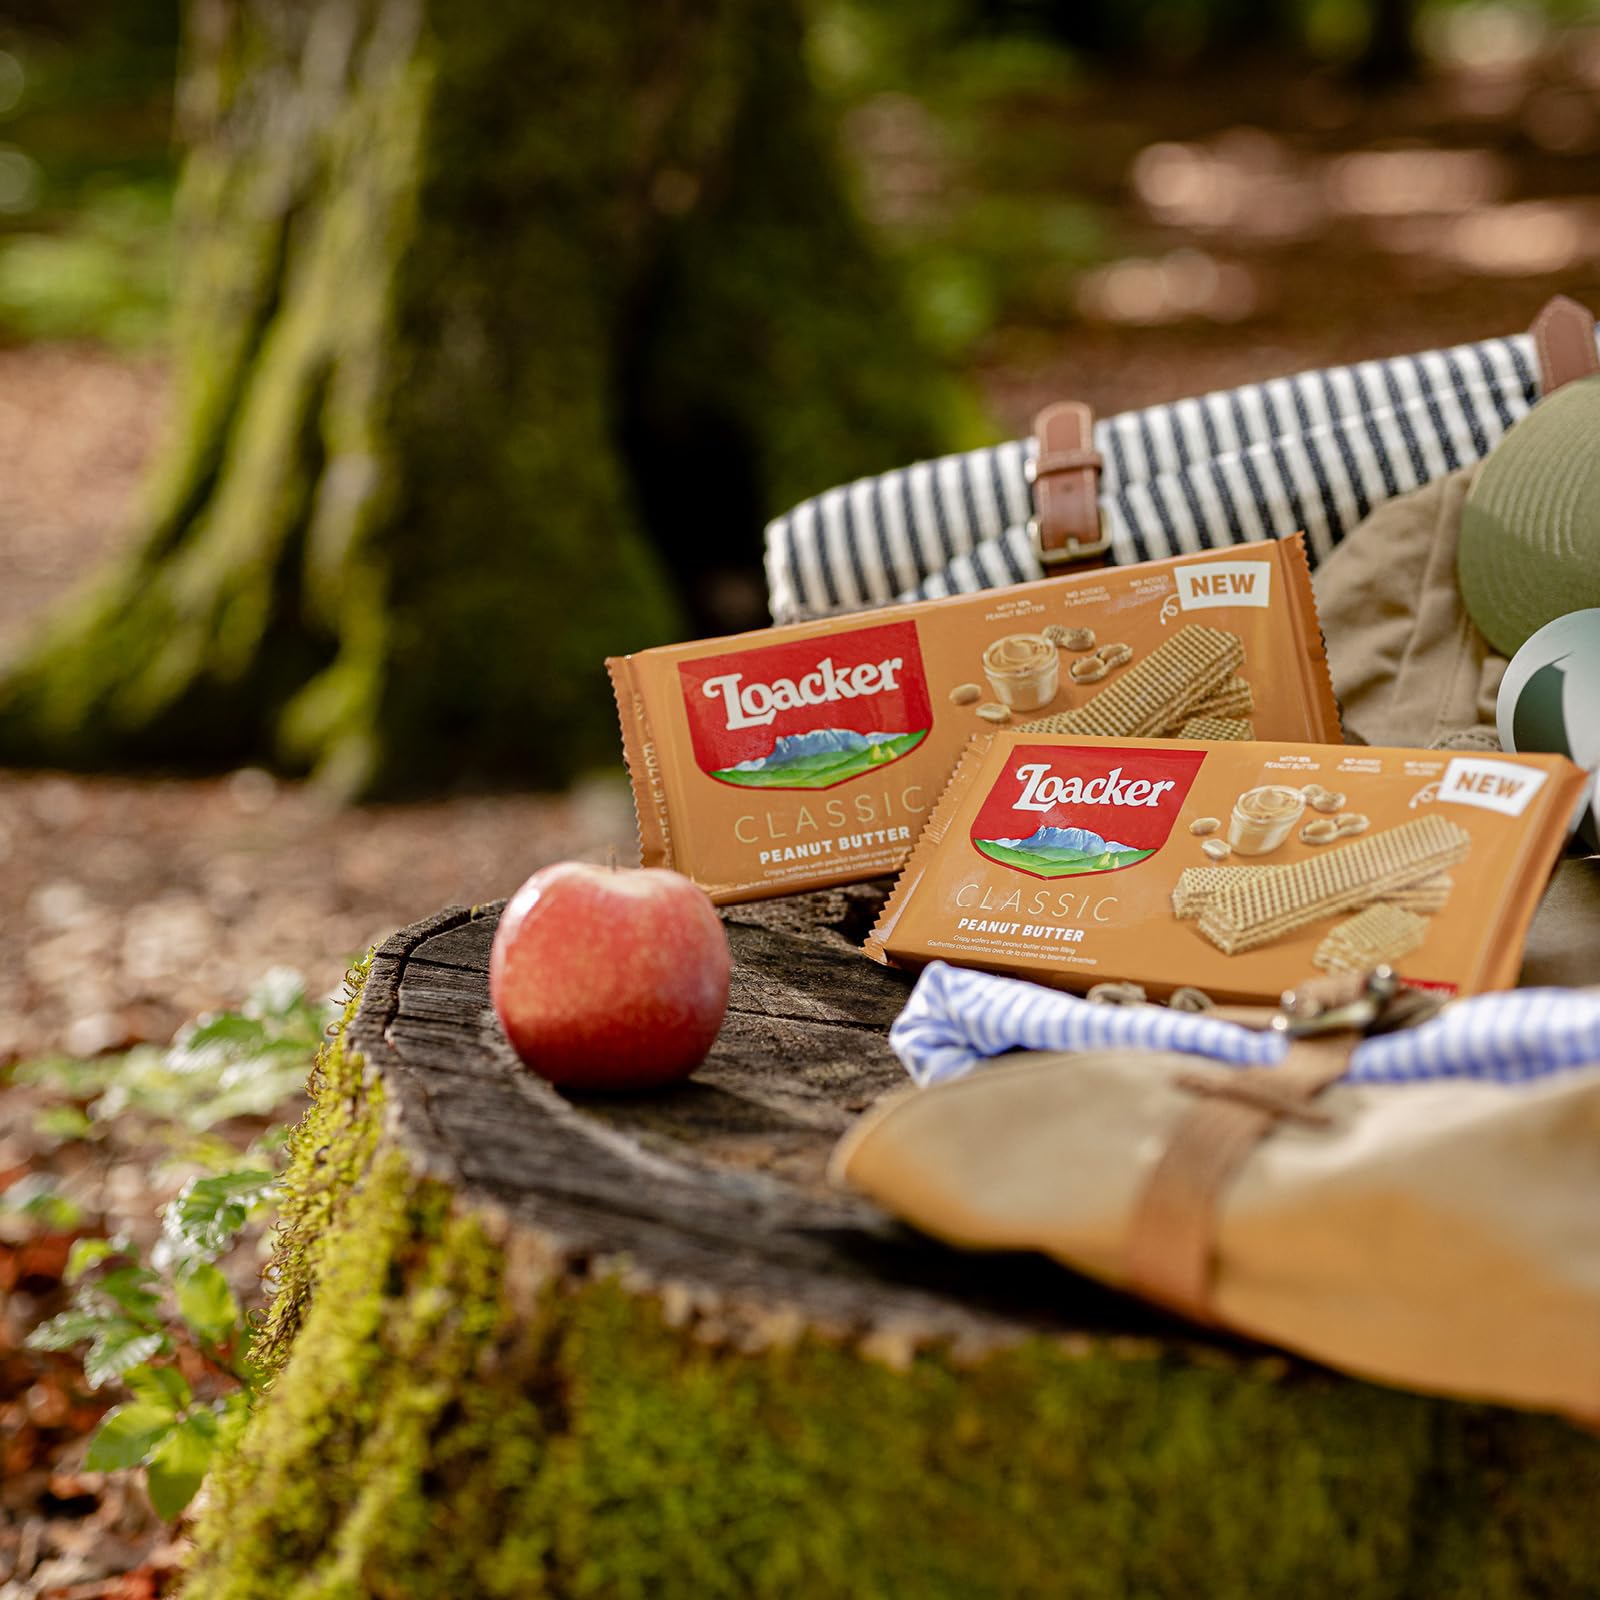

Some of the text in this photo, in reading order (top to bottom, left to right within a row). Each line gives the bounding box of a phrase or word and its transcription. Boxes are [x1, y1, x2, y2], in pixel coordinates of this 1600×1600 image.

[1190, 573, 1256, 598] NEW
[985, 604, 1045, 622] PEANUT BUTTER
[703, 657, 903, 730] Loacker
[1264, 761, 1290, 769] PEANUT
[1012, 764, 1175, 813] Loacker
[1454, 771, 1525, 799] NEW
[735, 786, 926, 843] CLASSIC
[759, 826, 911, 865] PEANUT BUTTER
[955, 884, 1118, 921] CLASSIC
[957, 918, 1084, 942] PEANUT BUTTER
[953, 934, 970, 943] Crispy
[971, 936, 990, 944] wafers
[1002, 940, 1022, 949] peanut
[1022, 942, 1040, 950] butter
[1060, 946, 1076, 955] filling
